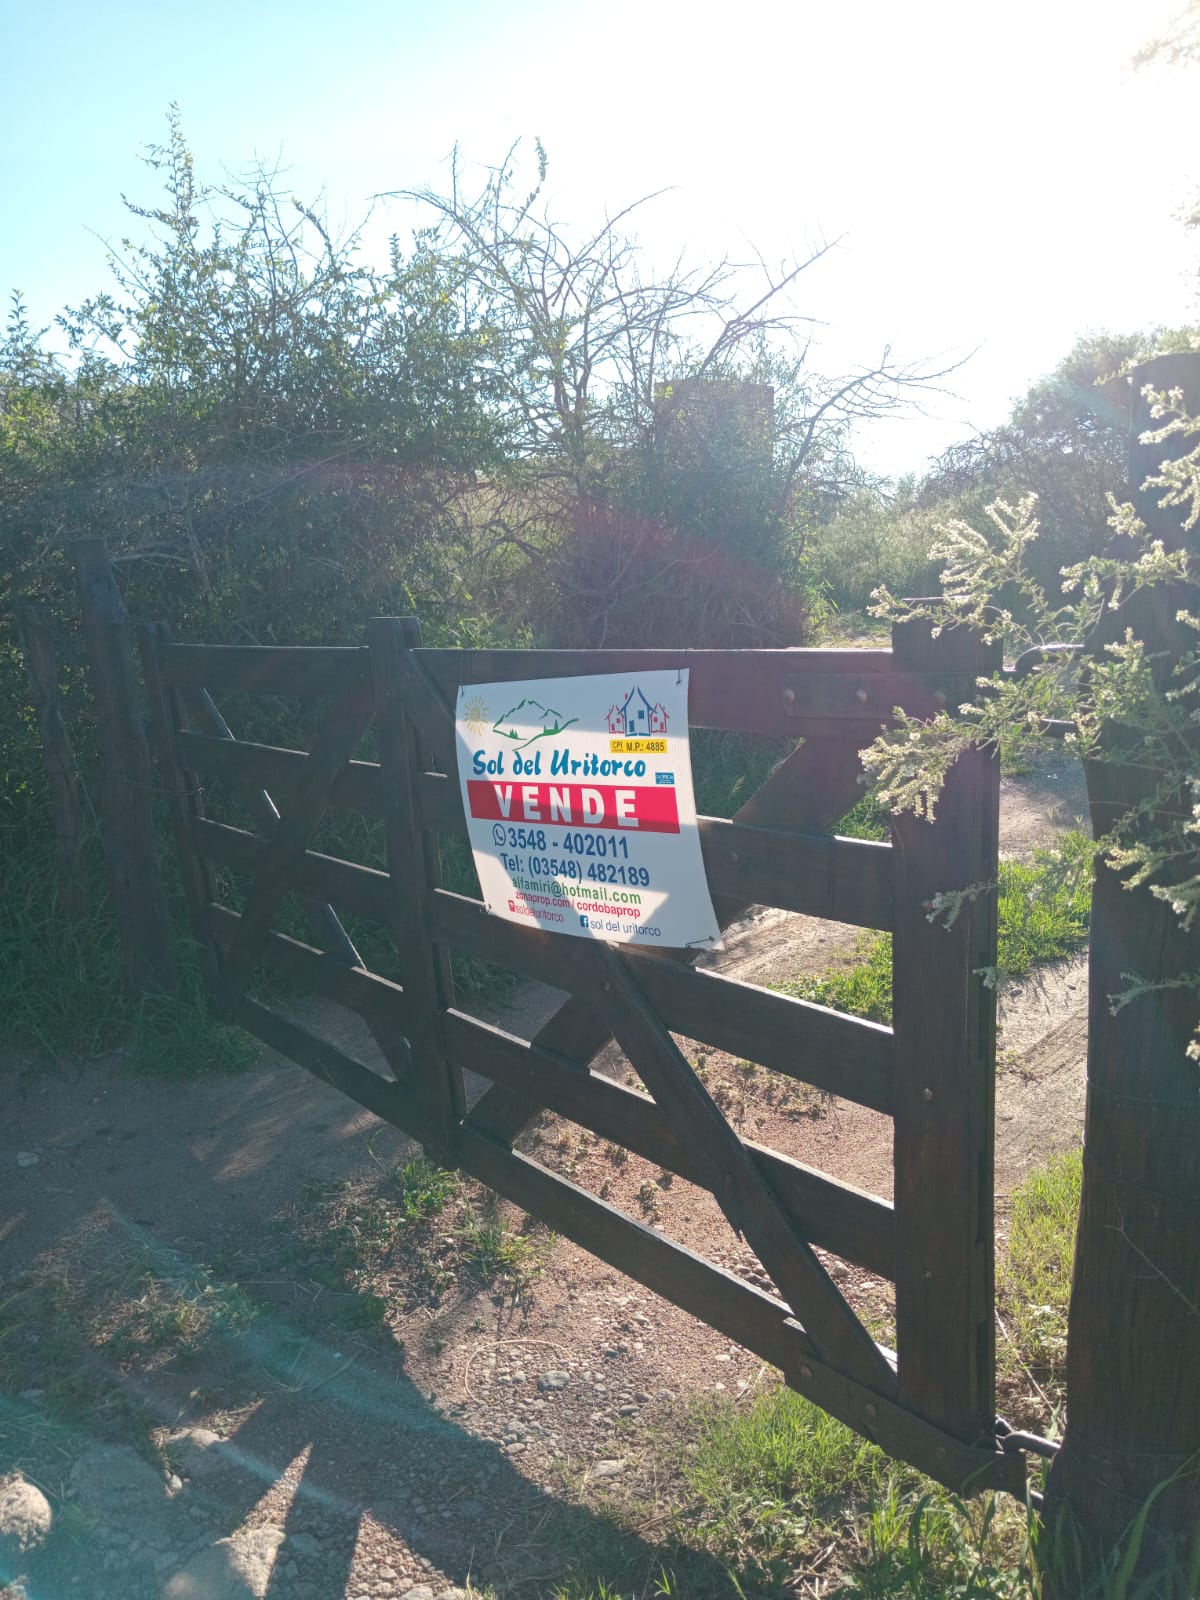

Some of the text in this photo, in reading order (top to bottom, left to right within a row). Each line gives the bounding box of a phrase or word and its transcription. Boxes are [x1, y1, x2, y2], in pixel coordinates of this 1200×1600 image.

[646, 742, 665, 752] 4885
[473, 749, 646, 777] Sol del Uritorco
[494, 784, 640, 827] VENDE
[508, 827, 547, 851] 3548
[564, 832, 629, 859] 402011
[501, 853, 650, 886] Tel: (03548) 482189
[512, 877, 642, 904] alfamiri@hotmail.com
[516, 892, 570, 909] zonaprop.com
[577, 901, 641, 919] cordobaprop
[516, 904, 564, 923] soldeluritorco
[590, 918, 661, 936] sol del uritorco
